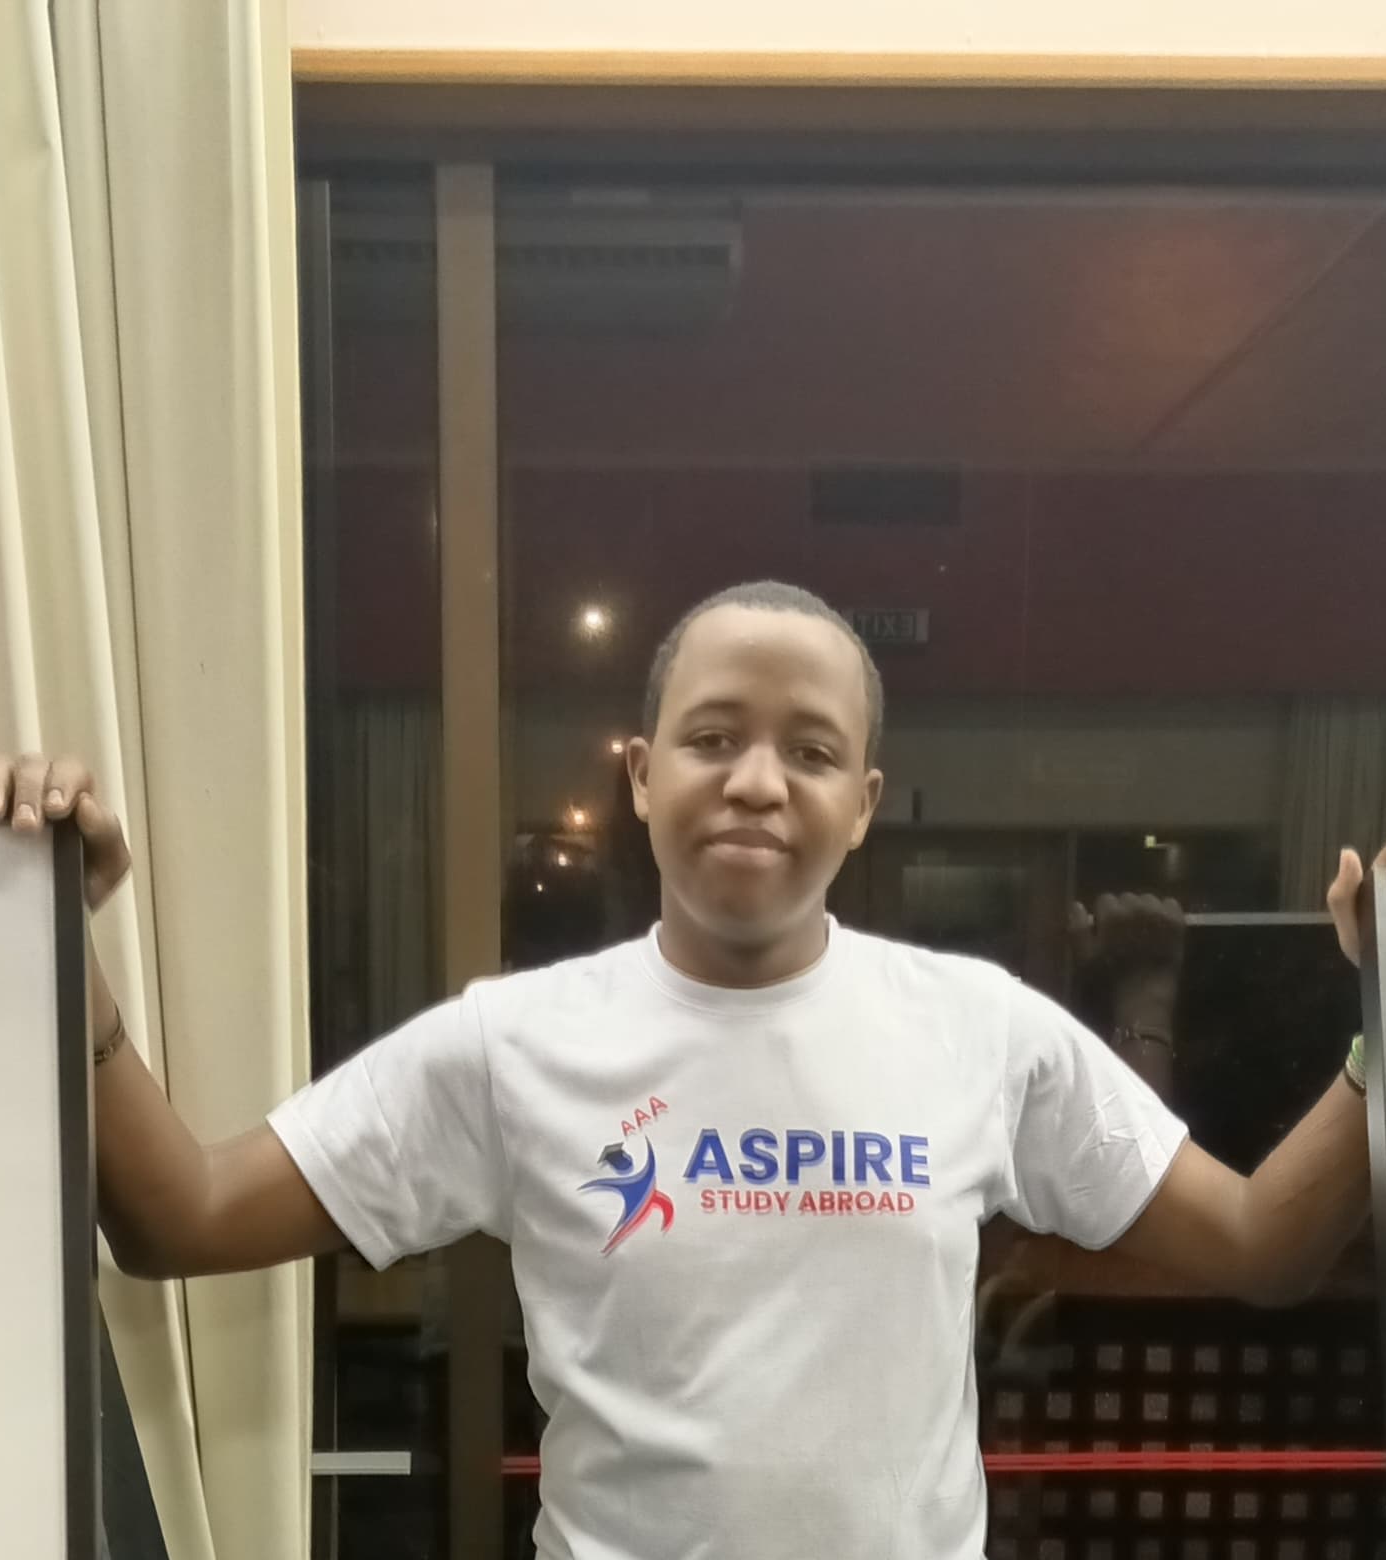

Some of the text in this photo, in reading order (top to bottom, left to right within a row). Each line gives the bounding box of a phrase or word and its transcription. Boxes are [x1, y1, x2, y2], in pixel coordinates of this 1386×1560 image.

[620, 1096, 669, 1137] AAA
[683, 1128, 931, 1189] ASPIRE
[700, 1190, 915, 1215] STUDY ABROAD
